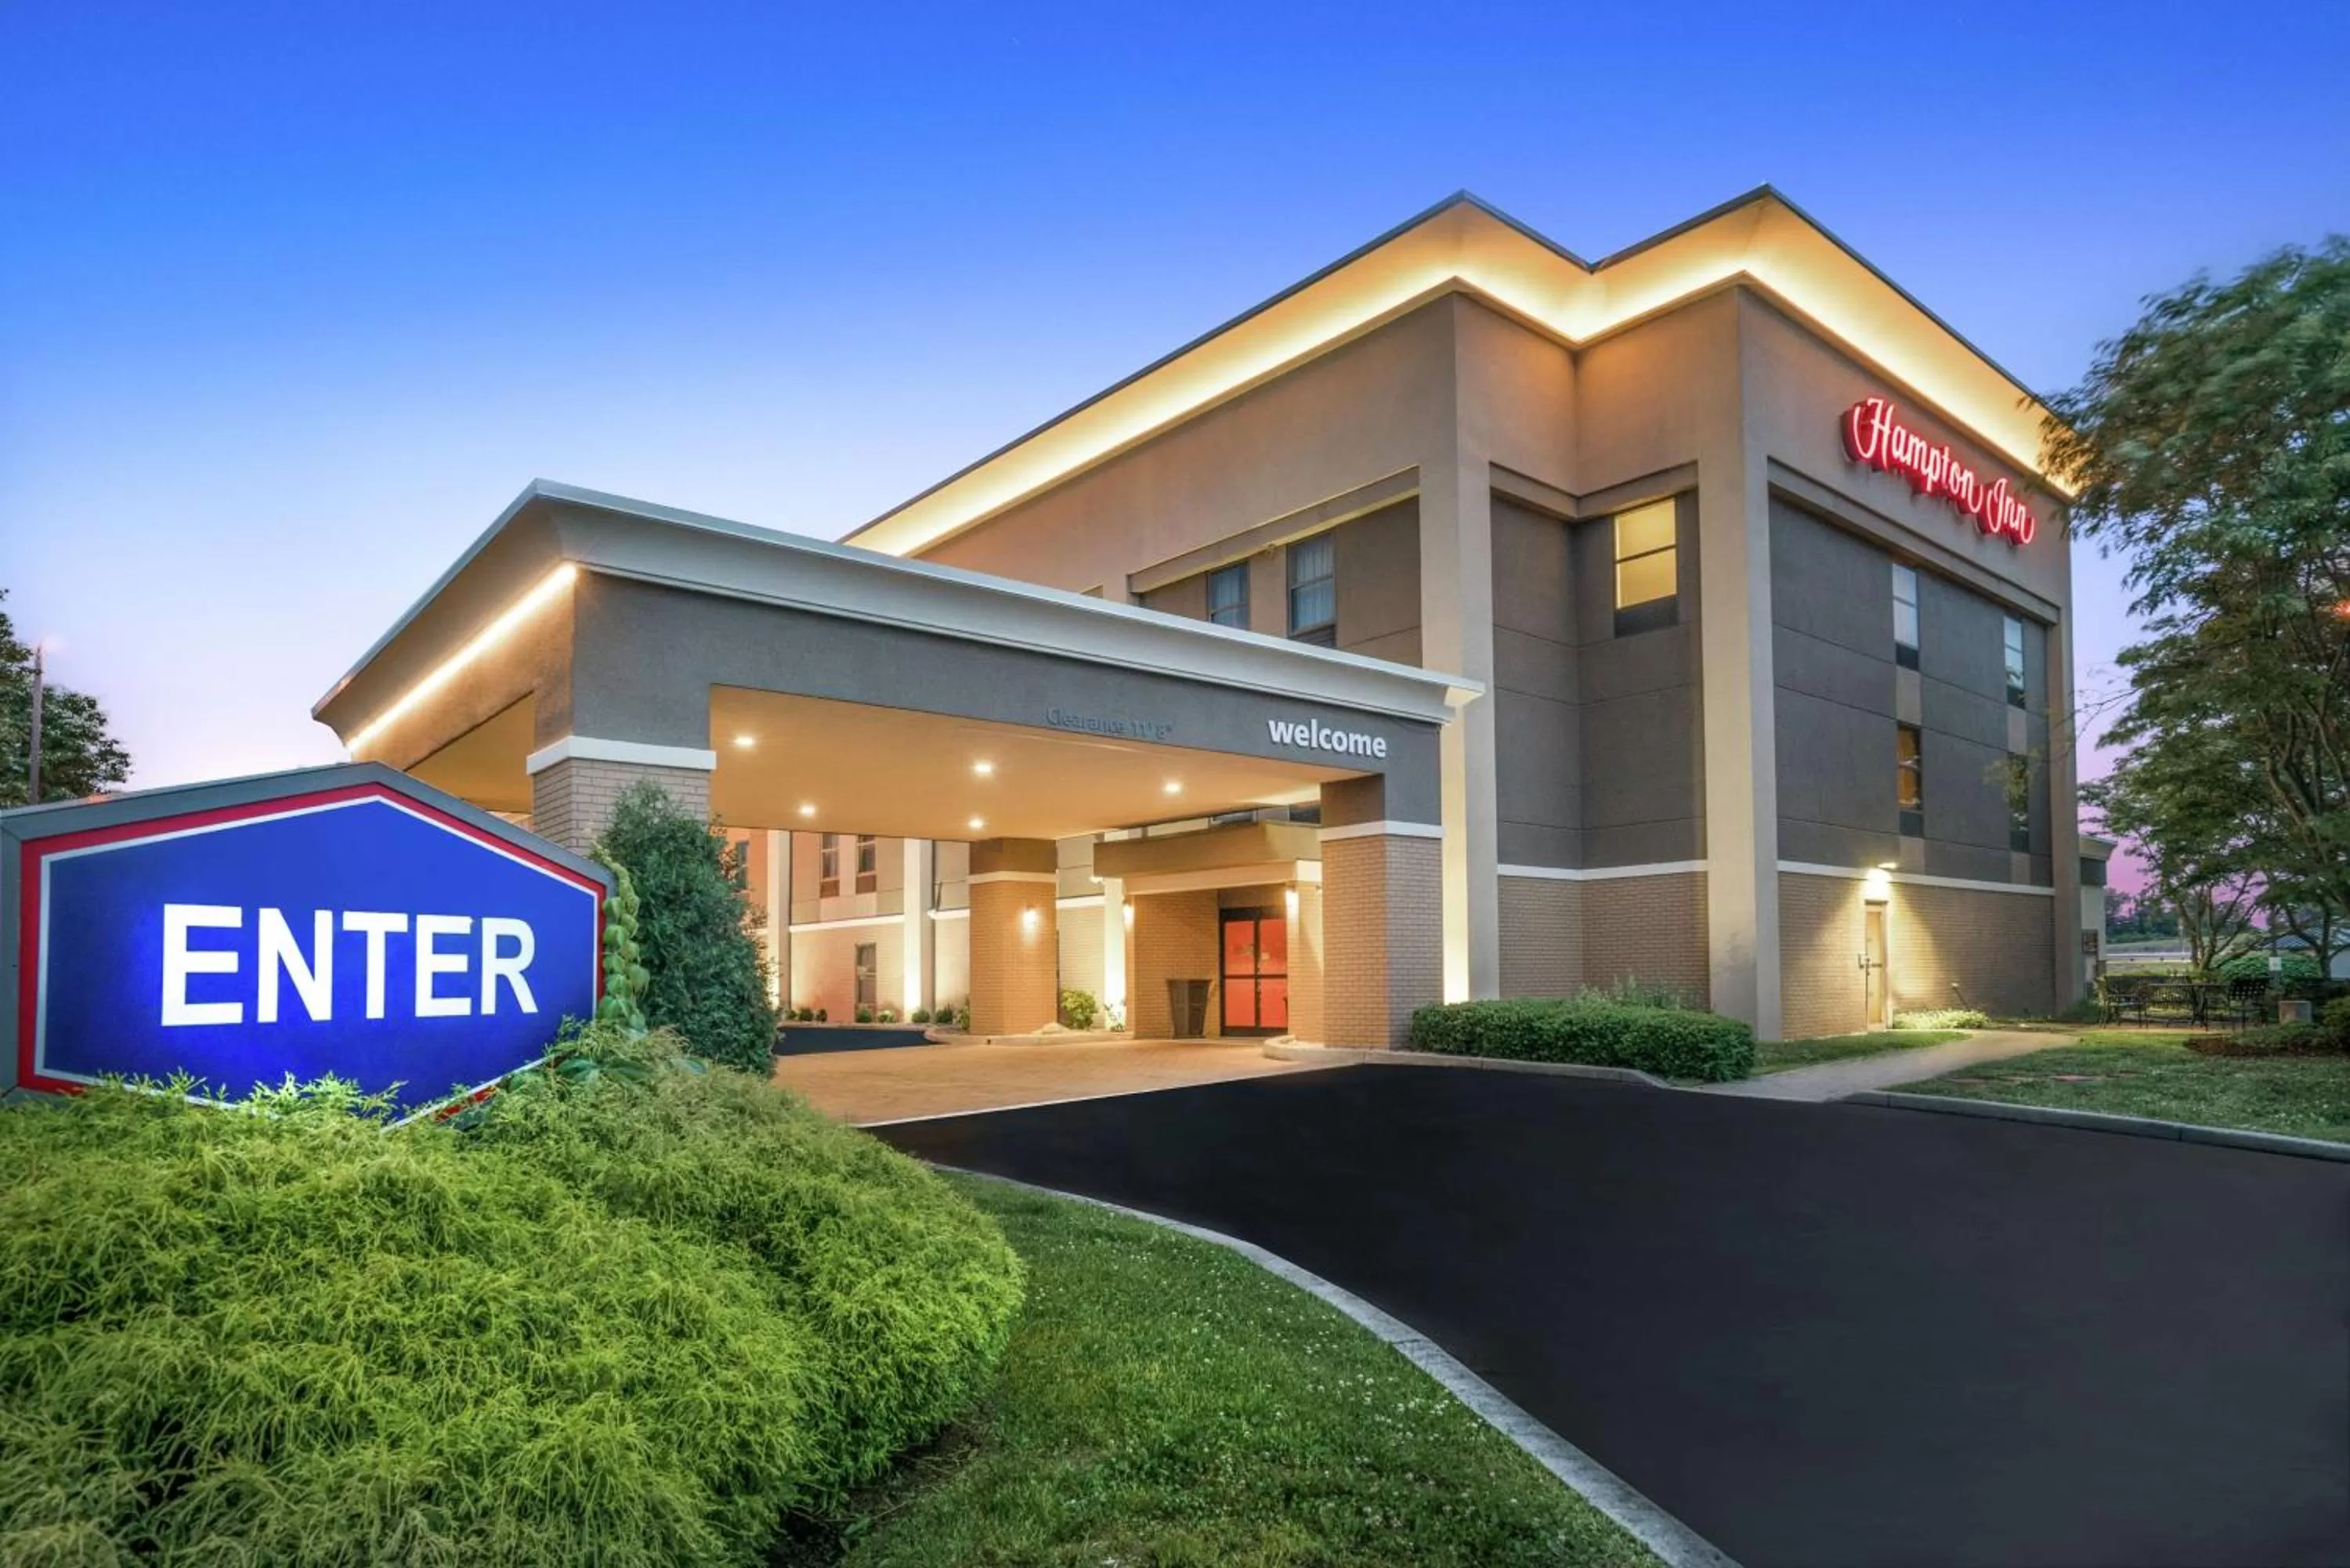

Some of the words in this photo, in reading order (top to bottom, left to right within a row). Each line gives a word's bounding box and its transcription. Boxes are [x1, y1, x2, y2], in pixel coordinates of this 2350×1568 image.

[1848, 397, 1983, 514] Hampton
[1986, 477, 2034, 544] Inn
[1045, 707, 1125, 735] Clearance
[1268, 718, 1386, 758] welcome
[161, 903, 538, 1027] ENTER
